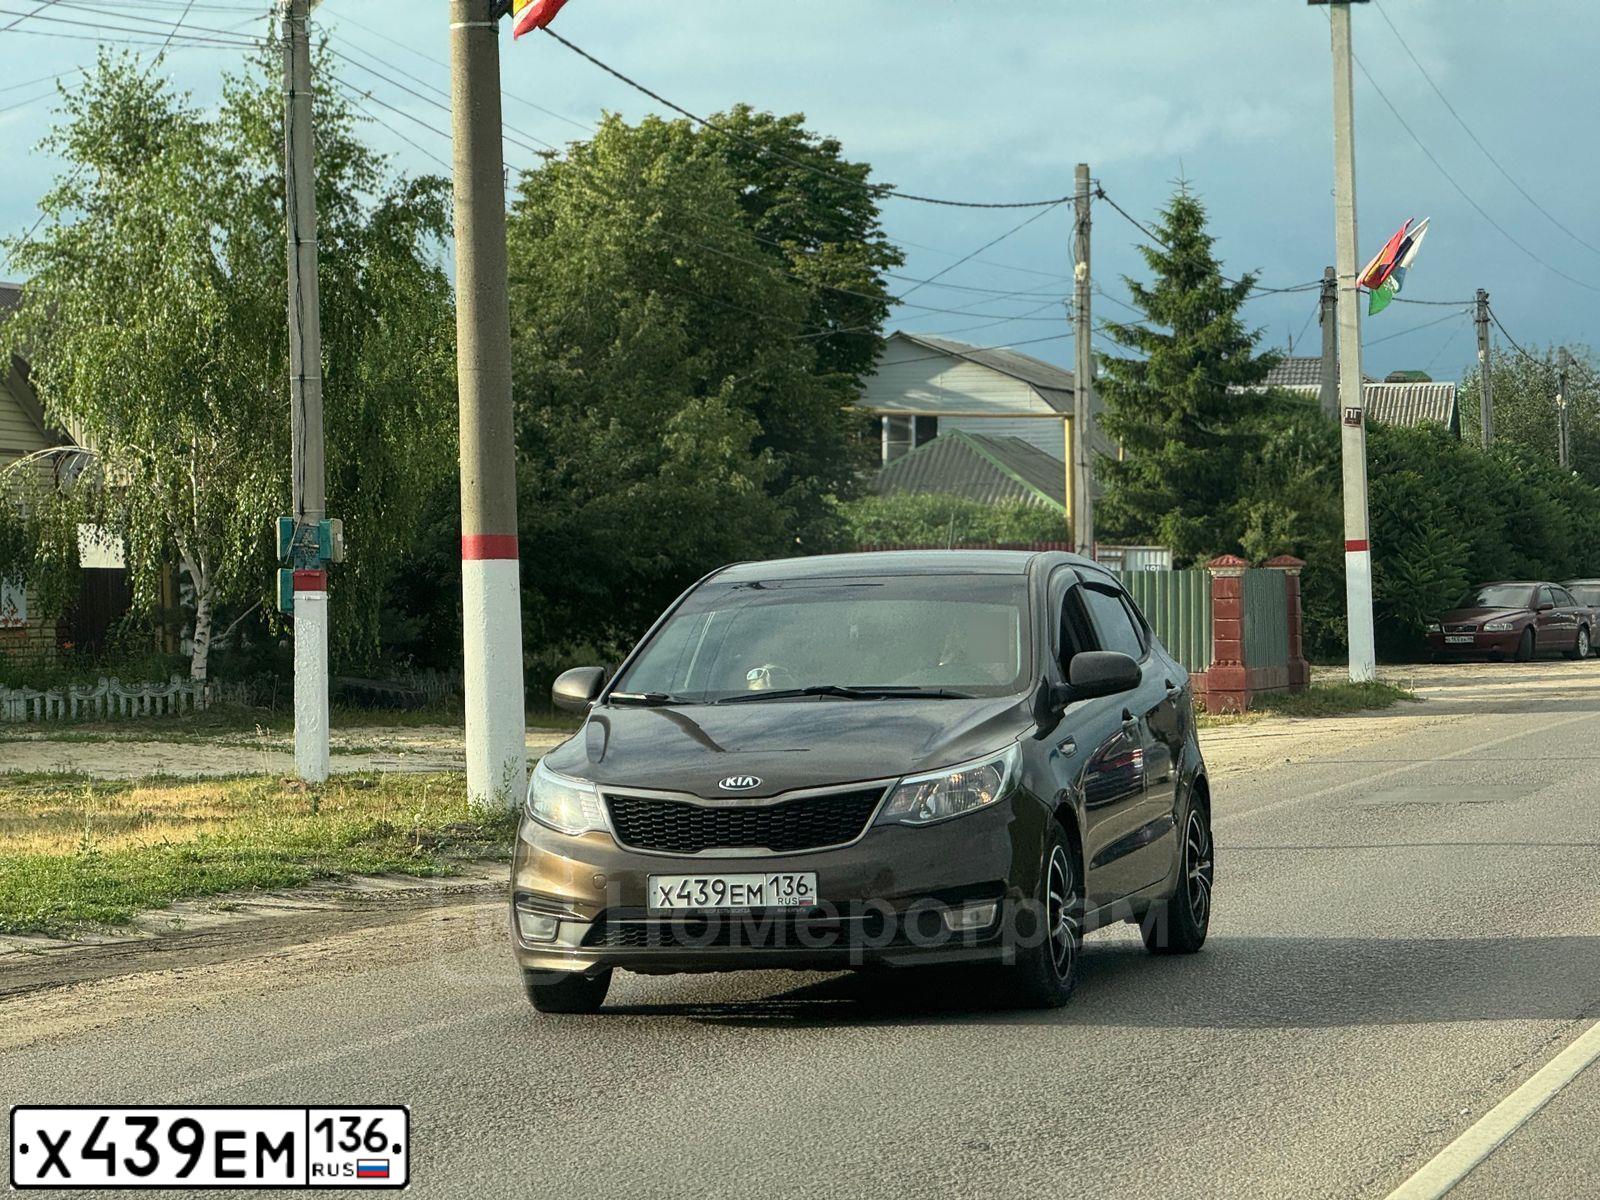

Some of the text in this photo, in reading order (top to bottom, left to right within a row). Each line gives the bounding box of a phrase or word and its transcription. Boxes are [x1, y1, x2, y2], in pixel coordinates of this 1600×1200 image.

[725, 776, 754, 788] KIA
[769, 875, 809, 897] 136
[777, 897, 798, 905] RUS
